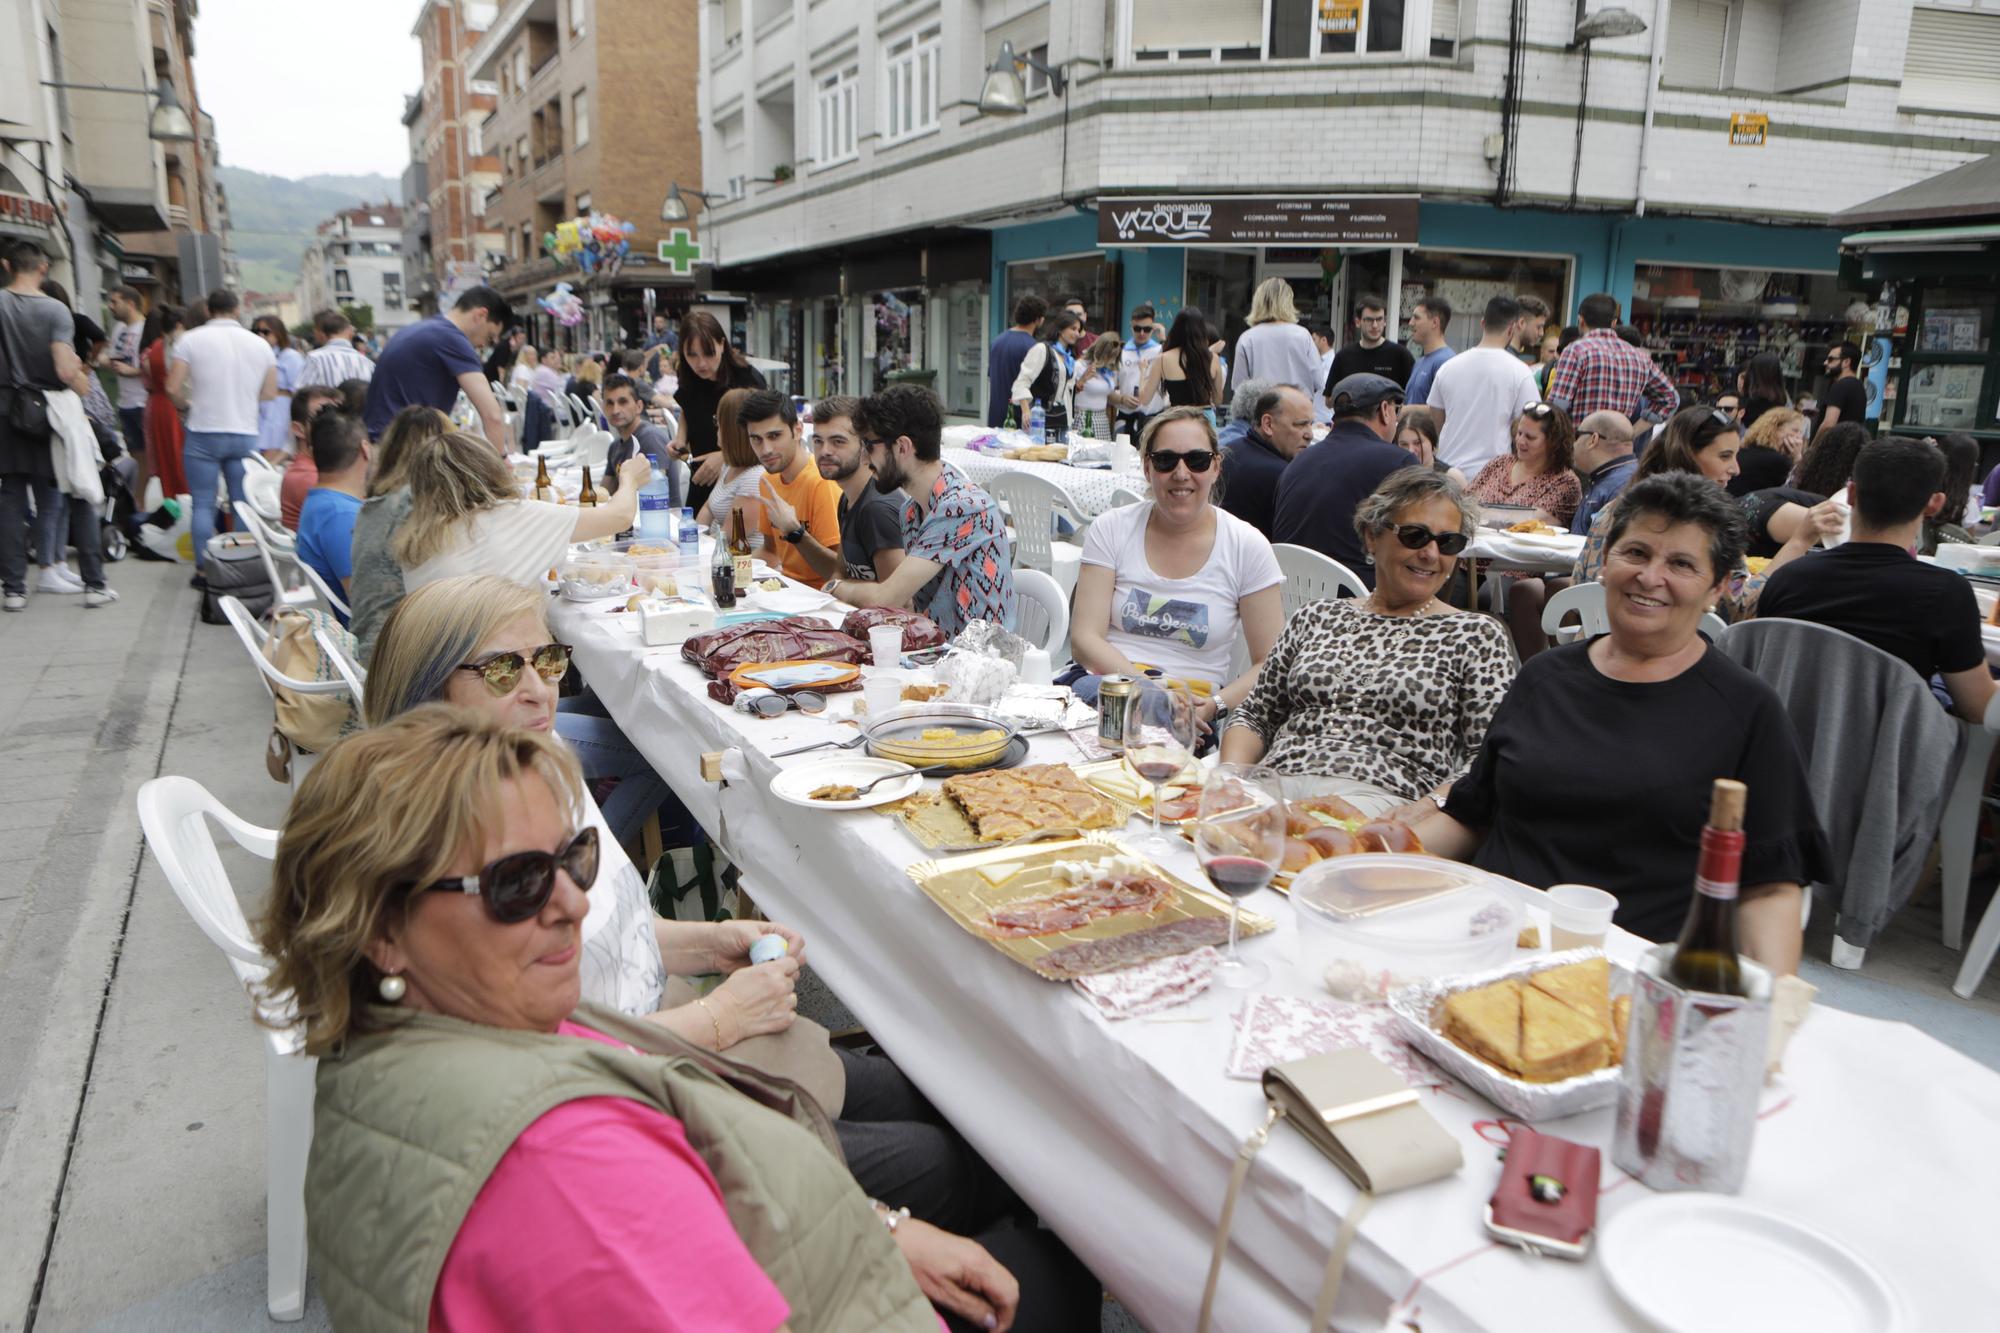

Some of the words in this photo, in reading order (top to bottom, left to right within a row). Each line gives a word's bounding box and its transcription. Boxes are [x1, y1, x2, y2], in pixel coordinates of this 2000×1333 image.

[1153, 203, 1212, 212] decoración
[1247, 214, 1288, 222] COMPLEMENTOS
[1121, 601, 1159, 627] Pepe
[1159, 612, 1209, 633] Jeans
